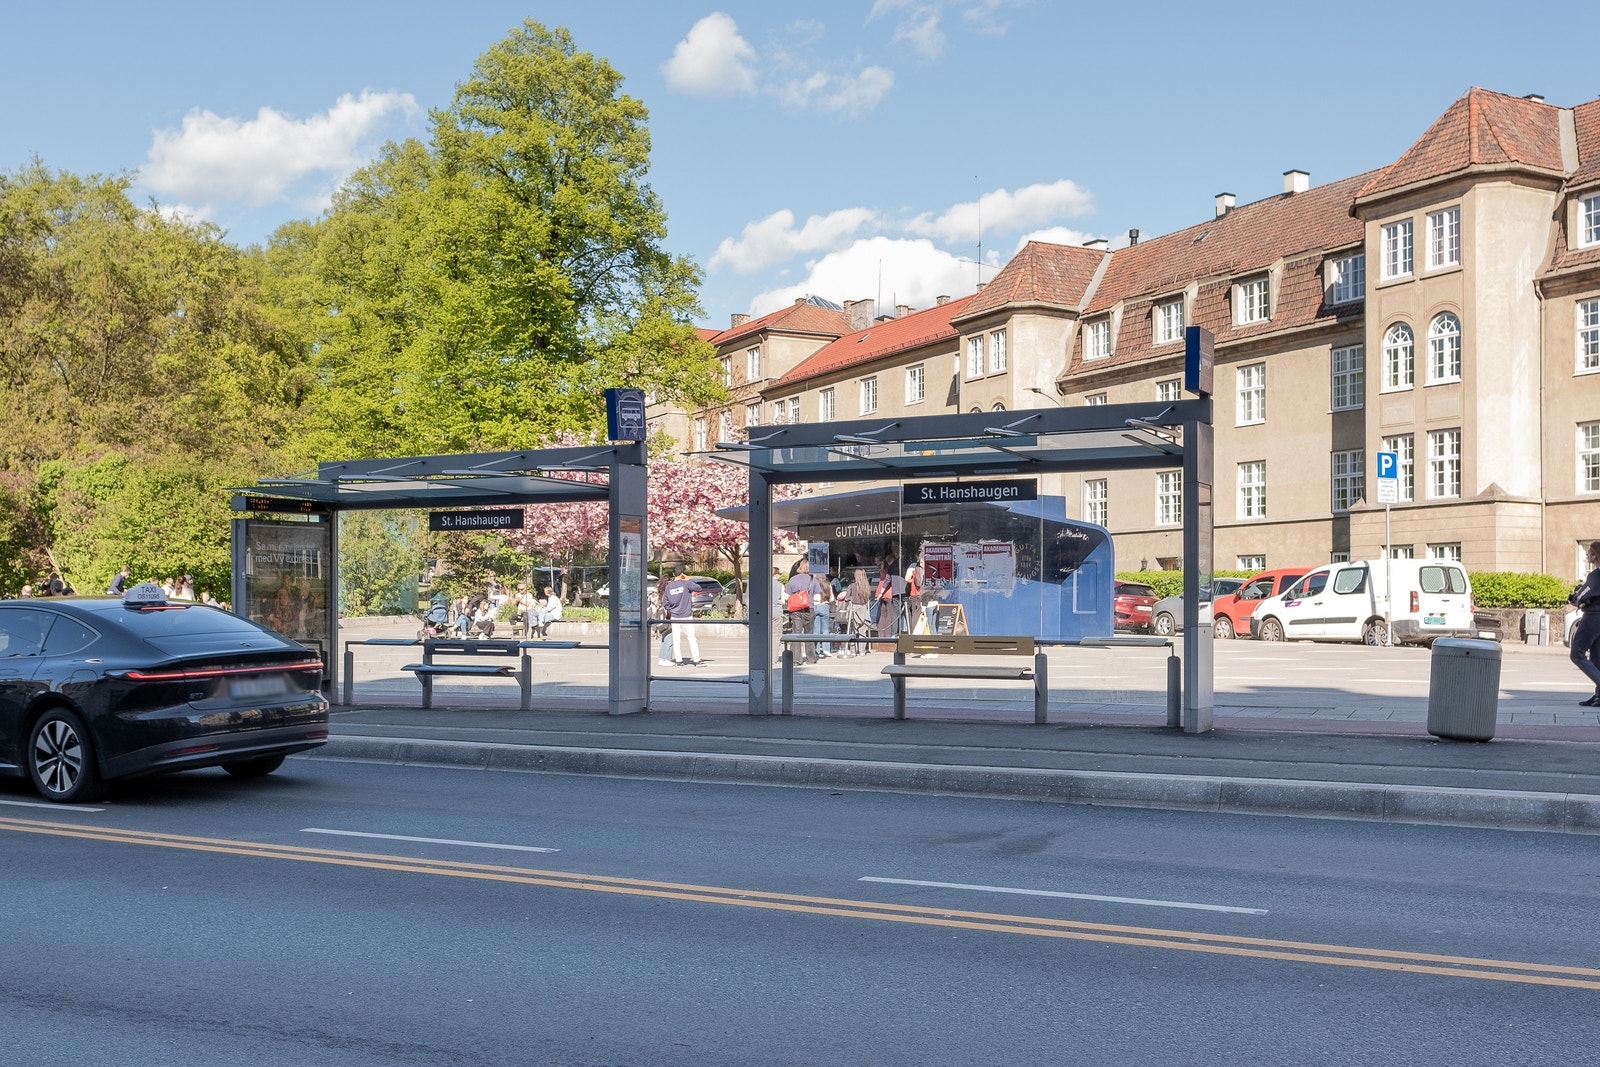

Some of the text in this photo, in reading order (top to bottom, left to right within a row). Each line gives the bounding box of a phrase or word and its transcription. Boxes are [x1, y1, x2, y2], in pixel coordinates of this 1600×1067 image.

[1381, 454, 1393, 476] P
[921, 485, 1019, 500] St. Hanshaugen
[441, 514, 511, 527] St. Hanshaugen
[835, 525, 862, 538] GUTTA
[866, 521, 903, 536] HAUGEN
[255, 553, 273, 563] med
[273, 553, 284, 565] Vy
[140, 586, 157, 594] TAXI
